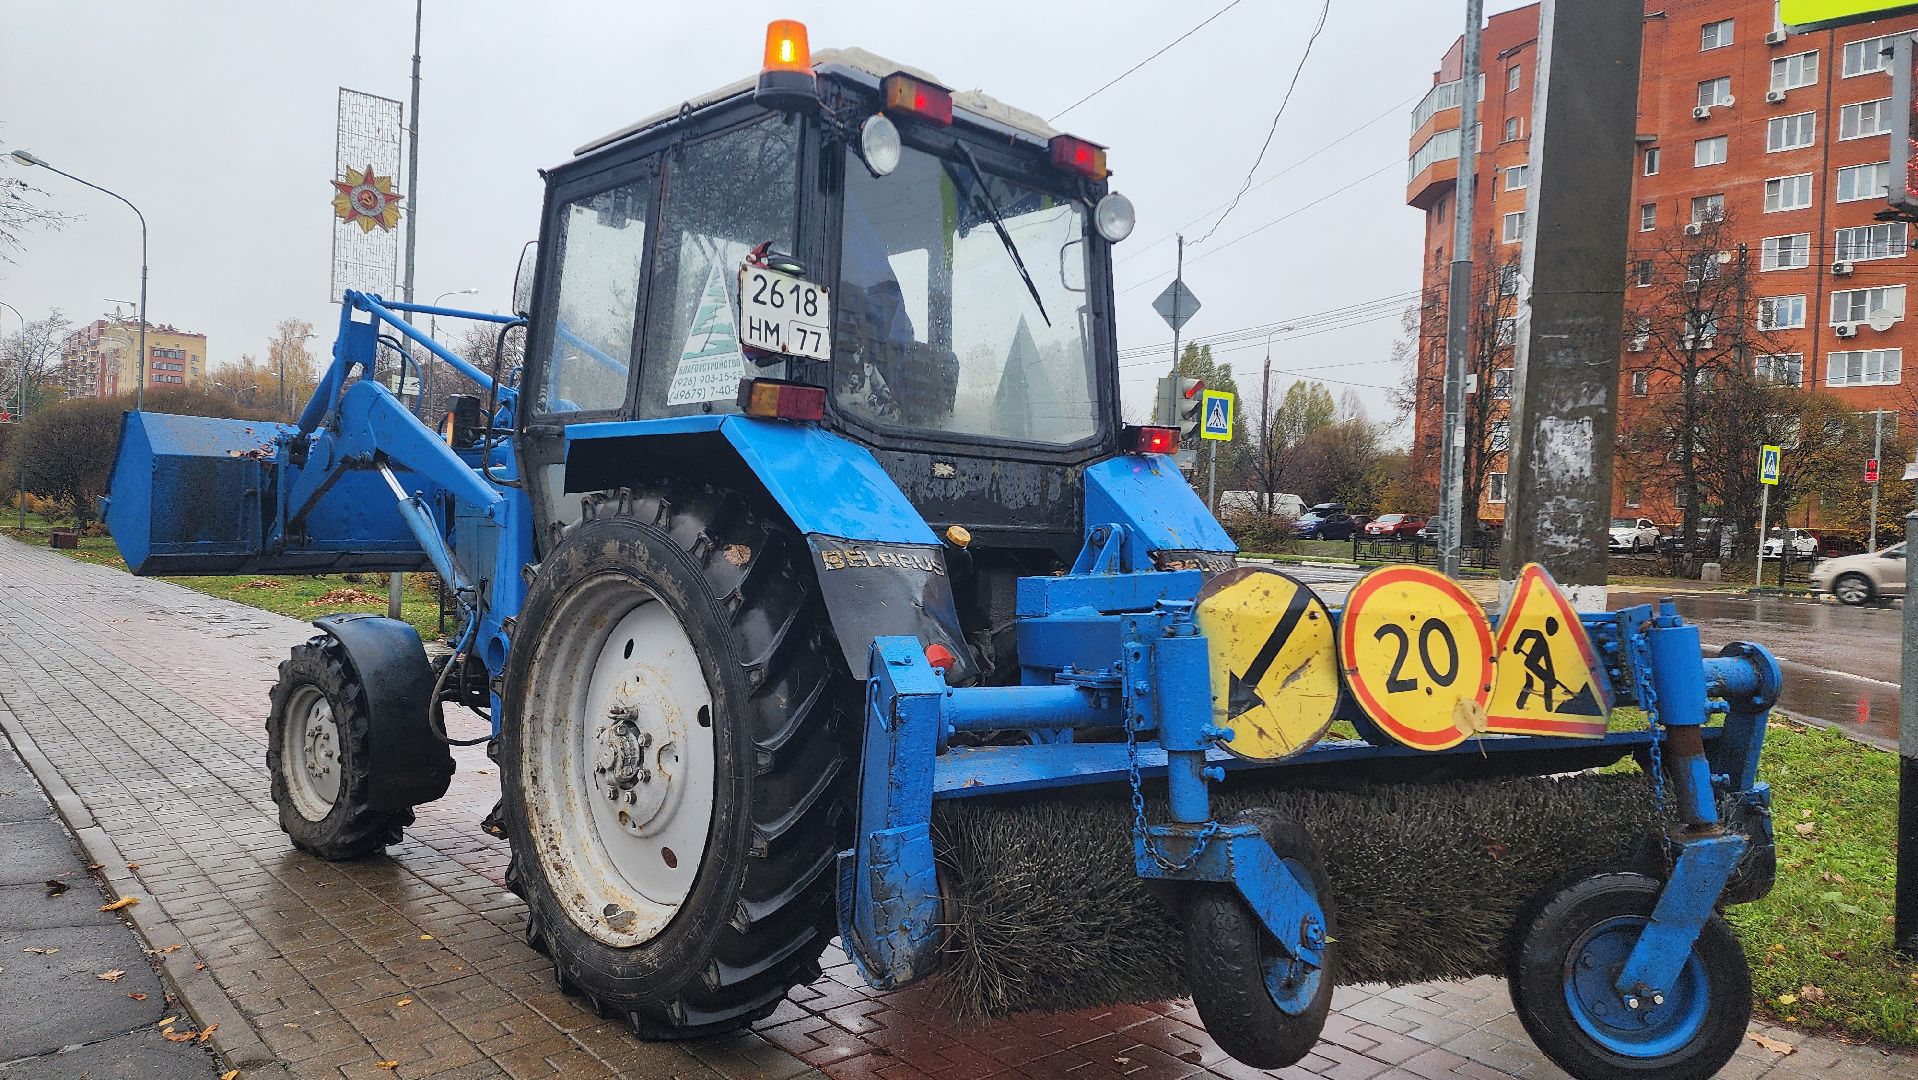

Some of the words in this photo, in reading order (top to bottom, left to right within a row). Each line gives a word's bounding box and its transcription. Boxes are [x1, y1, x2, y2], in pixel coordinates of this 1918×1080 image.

[752, 274, 818, 317] 2618
[749, 316, 780, 346] НМ
[796, 328, 822, 353] 77
[669, 388, 706, 403] (49679)
[710, 384, 738, 397] 7-40-5
[674, 377, 697, 389] (926)
[821, 549, 945, 577] BELARUS
[1373, 617, 1460, 695] 20
